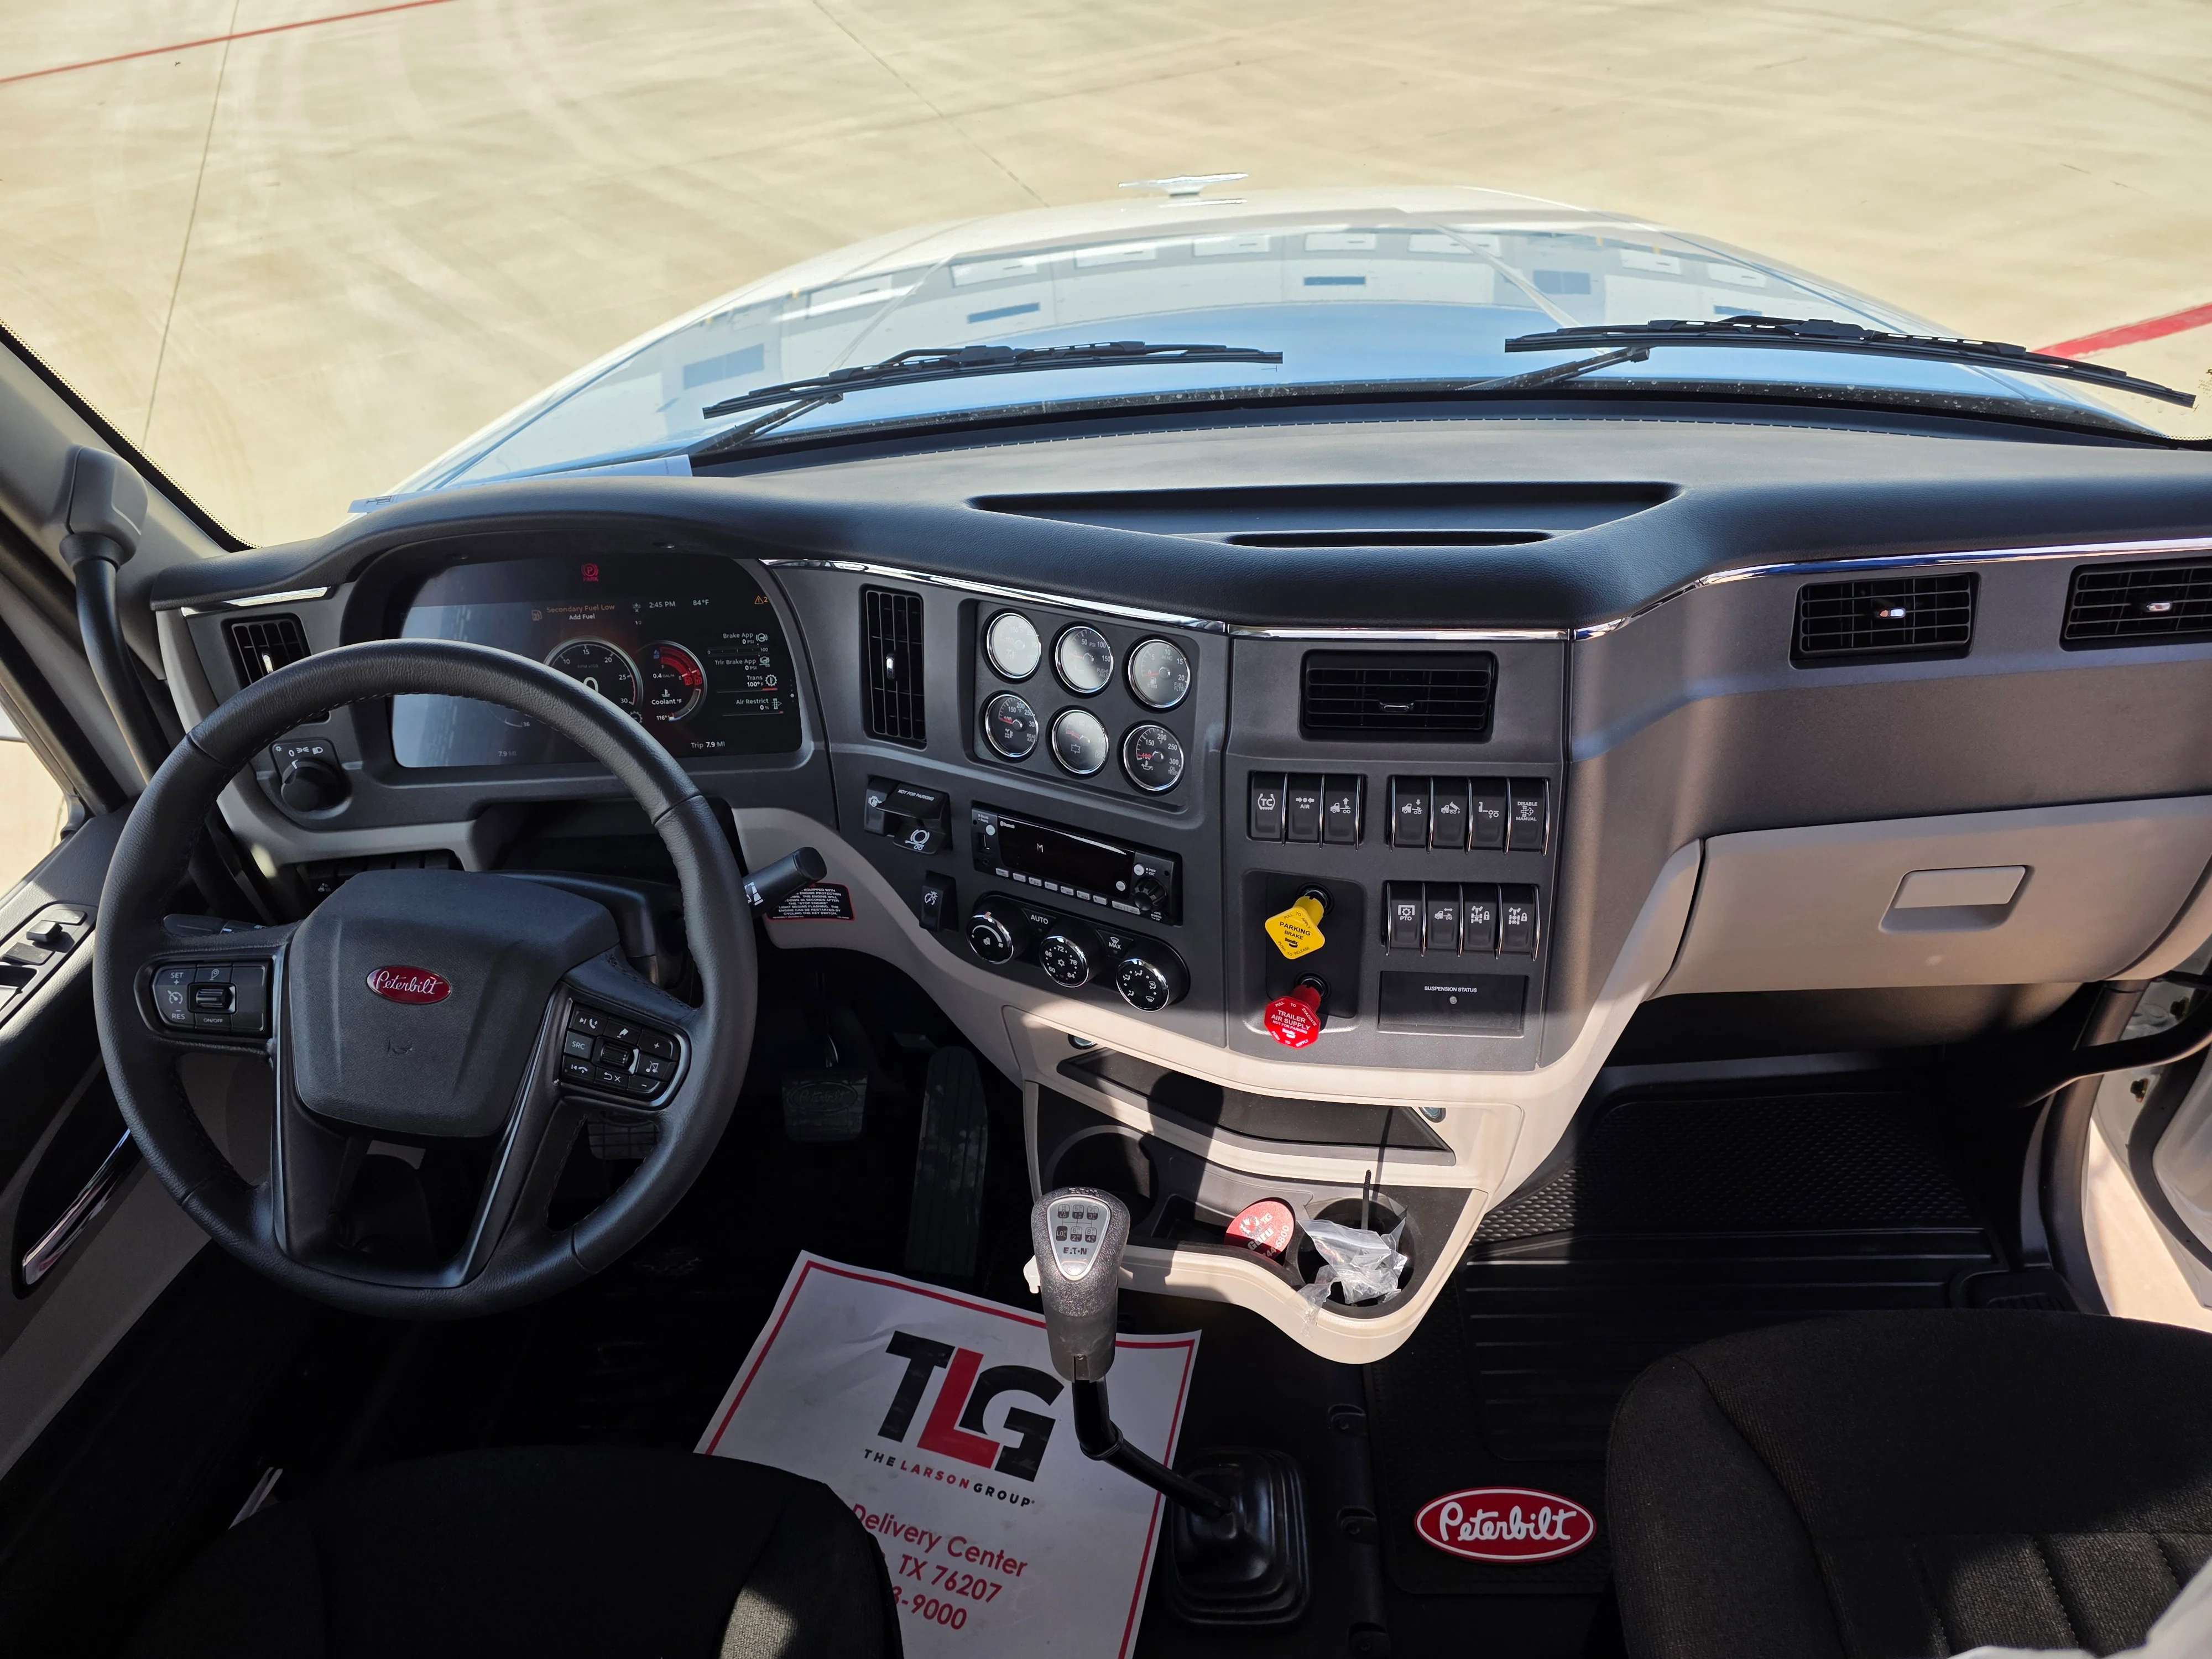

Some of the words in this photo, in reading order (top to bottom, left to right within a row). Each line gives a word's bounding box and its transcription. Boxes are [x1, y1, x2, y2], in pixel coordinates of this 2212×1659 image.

[1260, 798, 1272, 806] TC
[1031, 915, 1049, 925] AUTO
[1301, 917, 1312, 929] APPLY
[1279, 921, 1311, 936] PARKING
[1284, 930, 1304, 940] BRAKE
[1109, 942, 1121, 950] MAX
[1277, 941, 1286, 951] PUSH
[1293, 946, 1310, 955] RELEASE
[376, 971, 444, 994] Peterbilt
[1277, 1009, 1306, 1023] TRAILER
[1302, 1008, 1317, 1026] EVACUATE
[1284, 1018, 1311, 1031] SUPPLY
[1290, 1025, 1308, 1034] PARKING
[572, 1041, 585, 1050] SRC
[1271, 1030, 1280, 1041] PUSH
[1296, 1039, 1309, 1047] SUPPLY
[1247, 1227, 1275, 1250] Guru
[878, 1330, 1065, 1482] TLG
[864, 1449, 896, 1467] THE
[900, 1460, 969, 1489] LARSON
[973, 1483, 1031, 1507] GROUP
[1439, 1501, 1577, 1542] Peterbilt
[853, 1503, 942, 1553] Delivery
[947, 1536, 1028, 1577] Center
[899, 1553, 928, 1581] TX
[931, 1565, 1003, 1603] 76207
